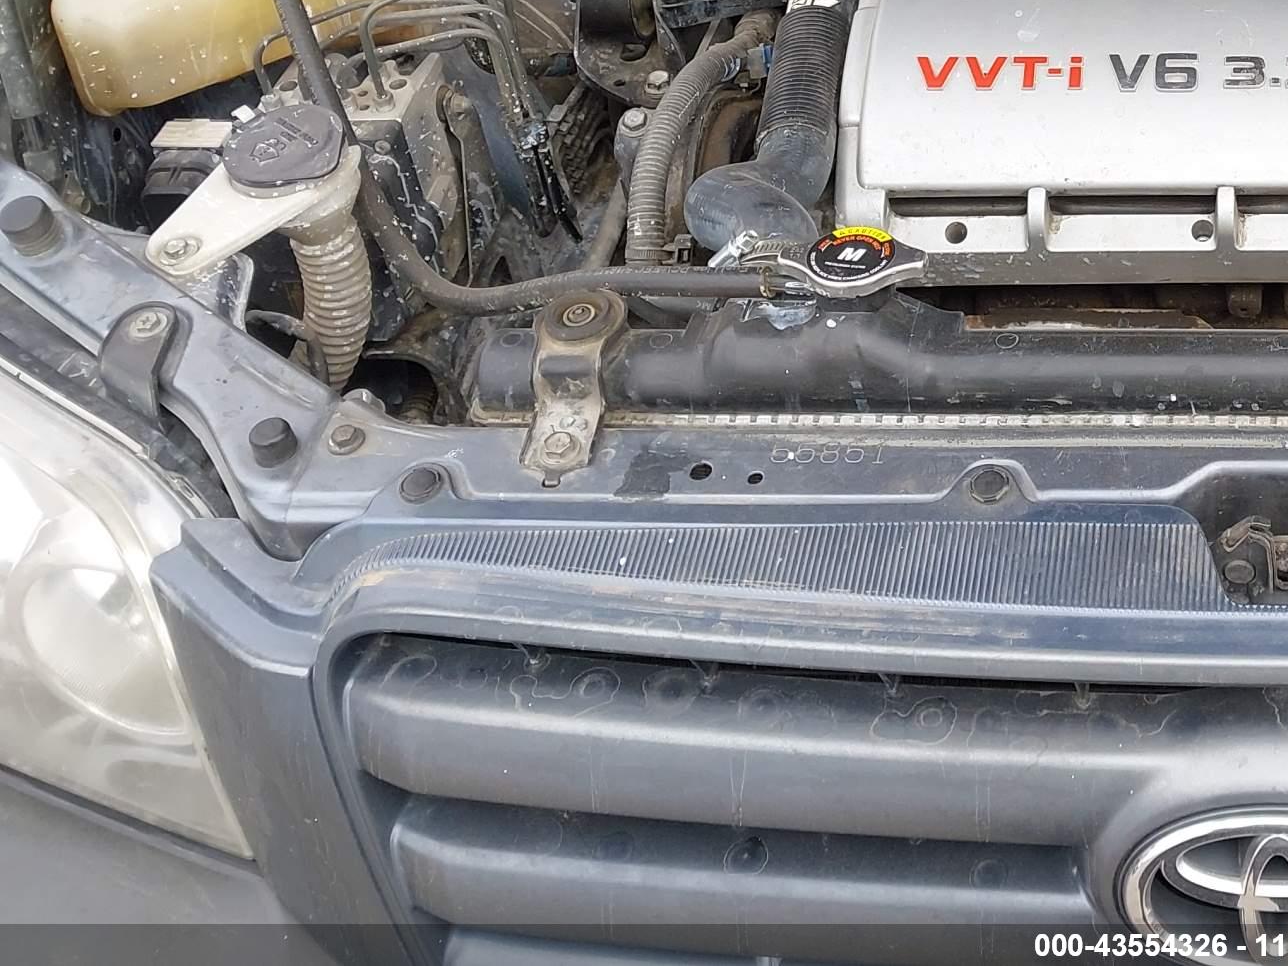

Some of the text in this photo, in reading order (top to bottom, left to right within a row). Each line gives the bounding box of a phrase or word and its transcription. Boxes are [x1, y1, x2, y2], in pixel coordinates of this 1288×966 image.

[916, 51, 1086, 92] VVT-i
[1109, 52, 1201, 93] V6
[837, 247, 867, 262] M
